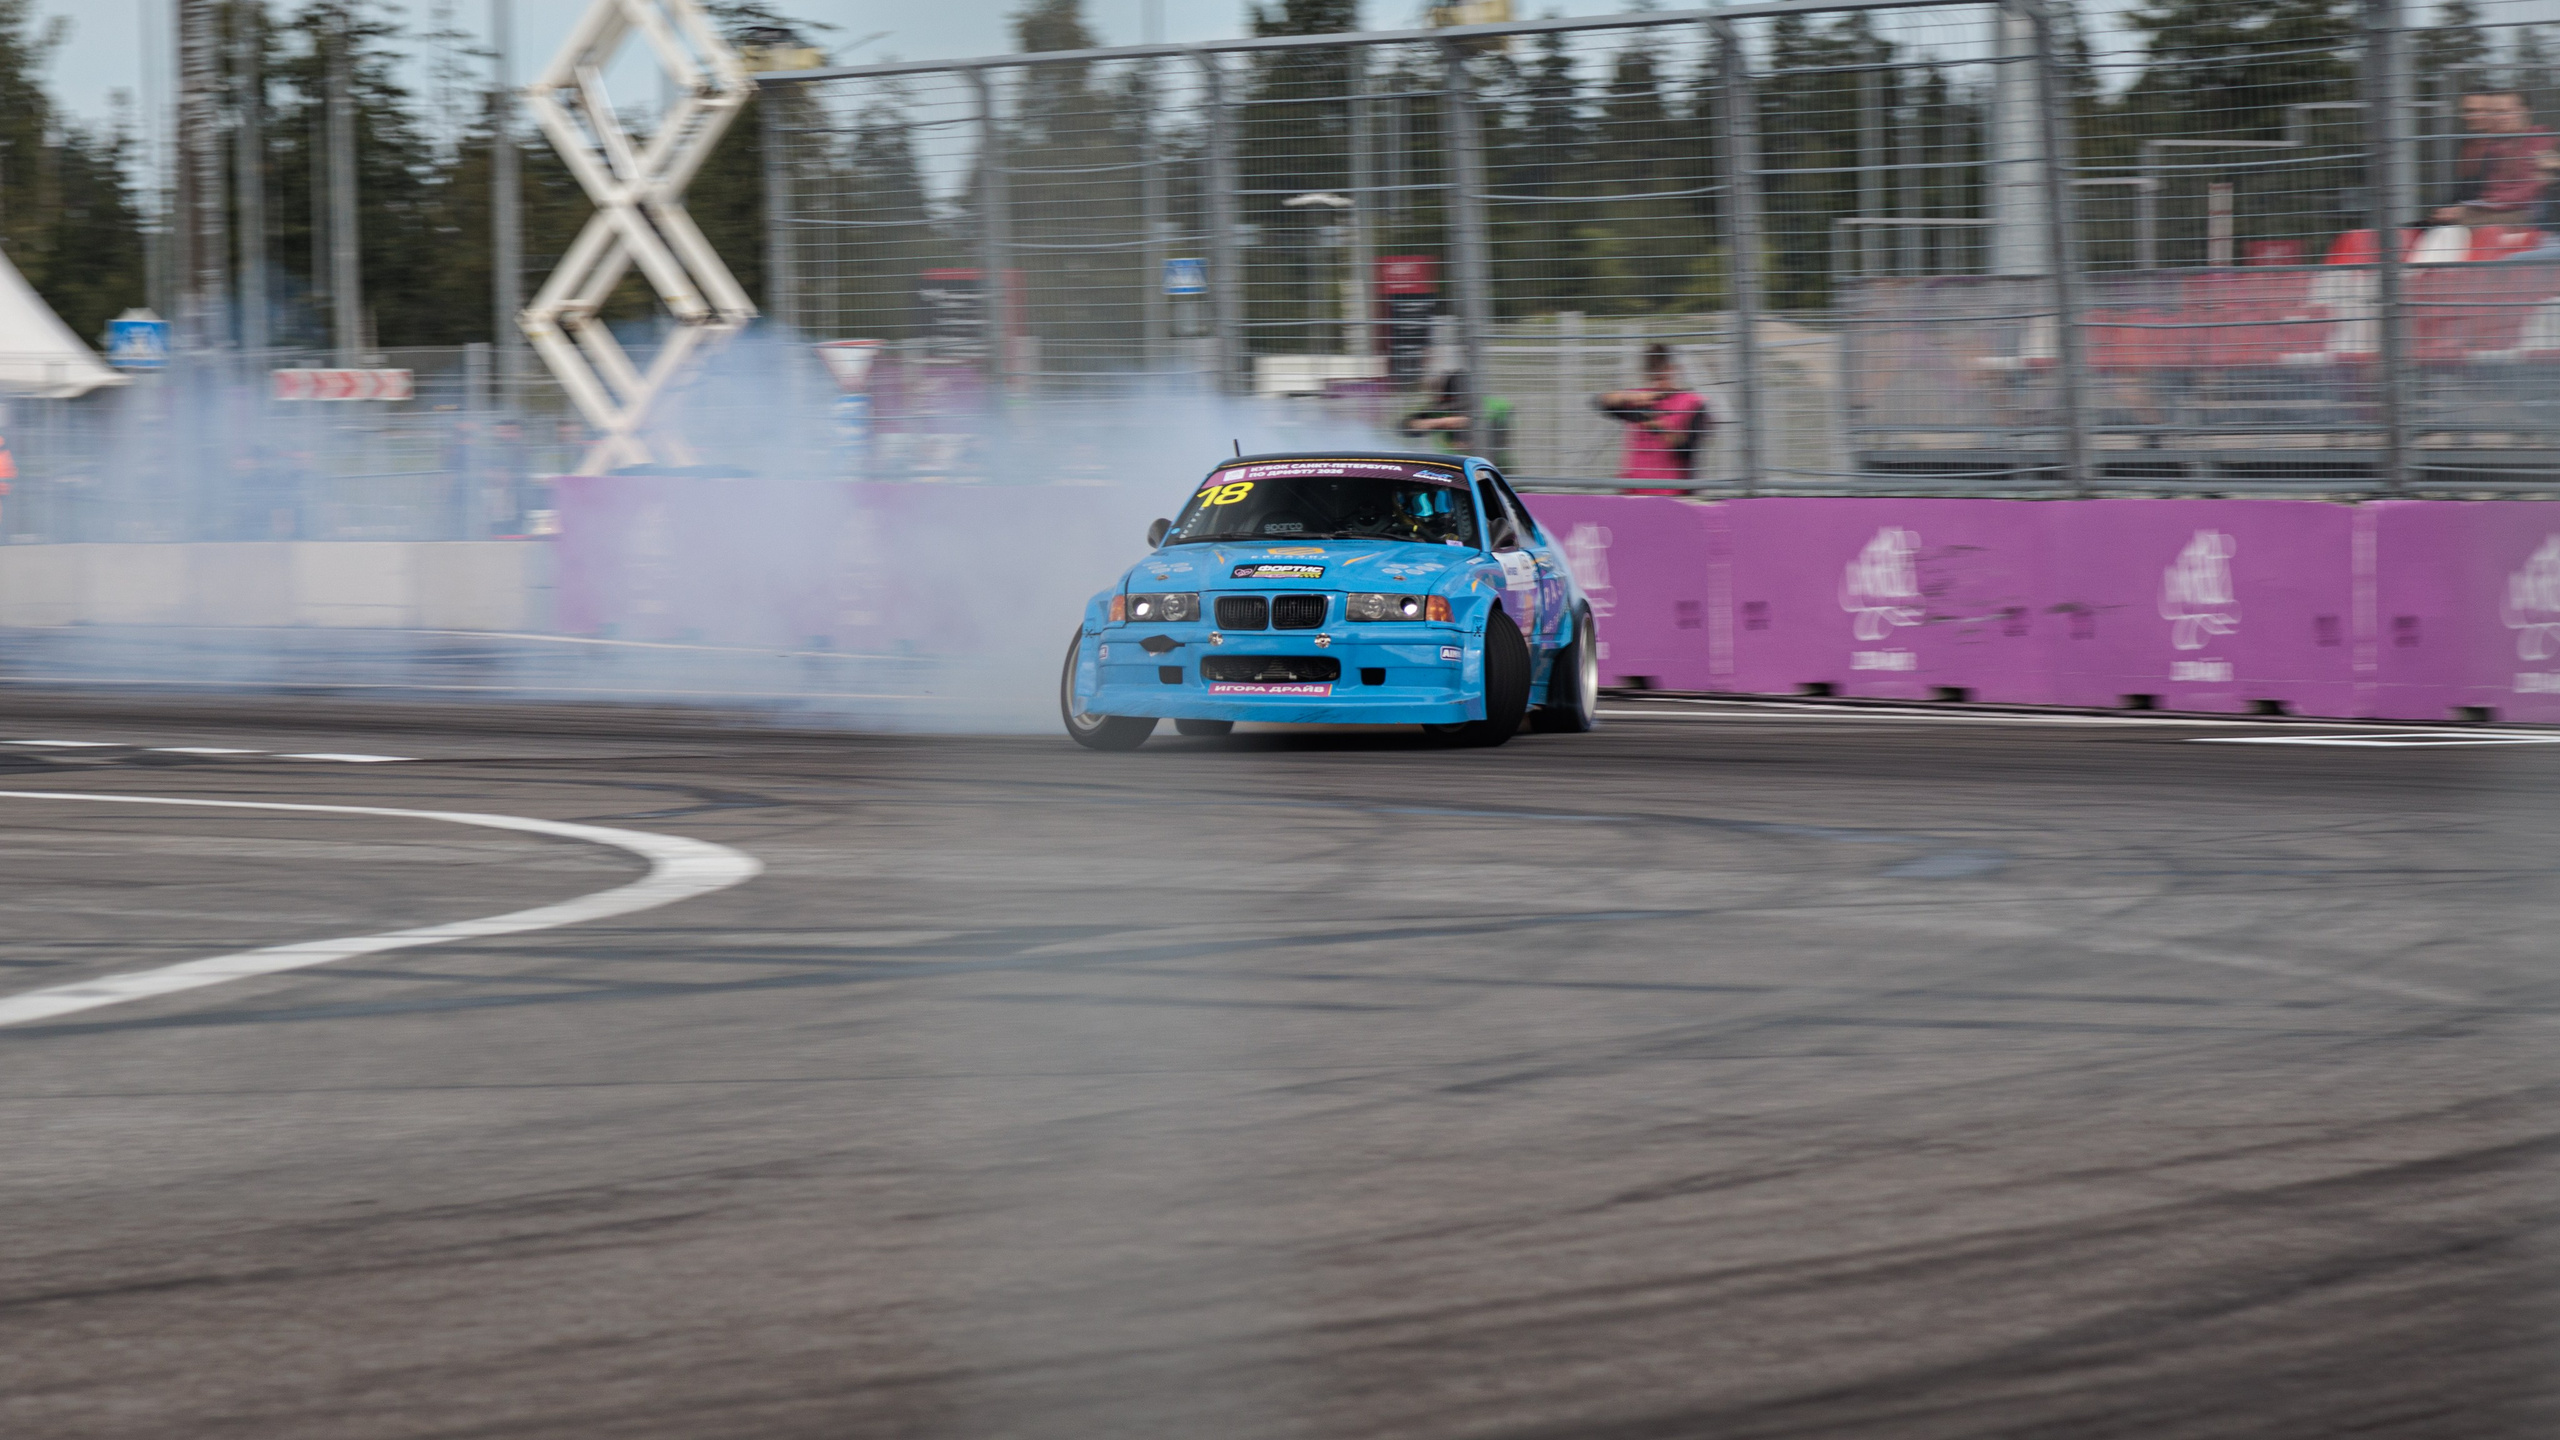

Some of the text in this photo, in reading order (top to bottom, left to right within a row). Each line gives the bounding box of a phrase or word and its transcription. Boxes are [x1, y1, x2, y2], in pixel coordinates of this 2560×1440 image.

[1250, 462, 1402, 472] КУБОК САНКТ-ПЕТЕРБУРГА
[1266, 469, 1315, 477] ДРИФТУ
[1196, 481, 1254, 508] 18
[1264, 522, 1303, 532] sparco
[1257, 565, 1324, 573] ФОРТИС
[1268, 684, 1324, 693] ДРАЙВ
